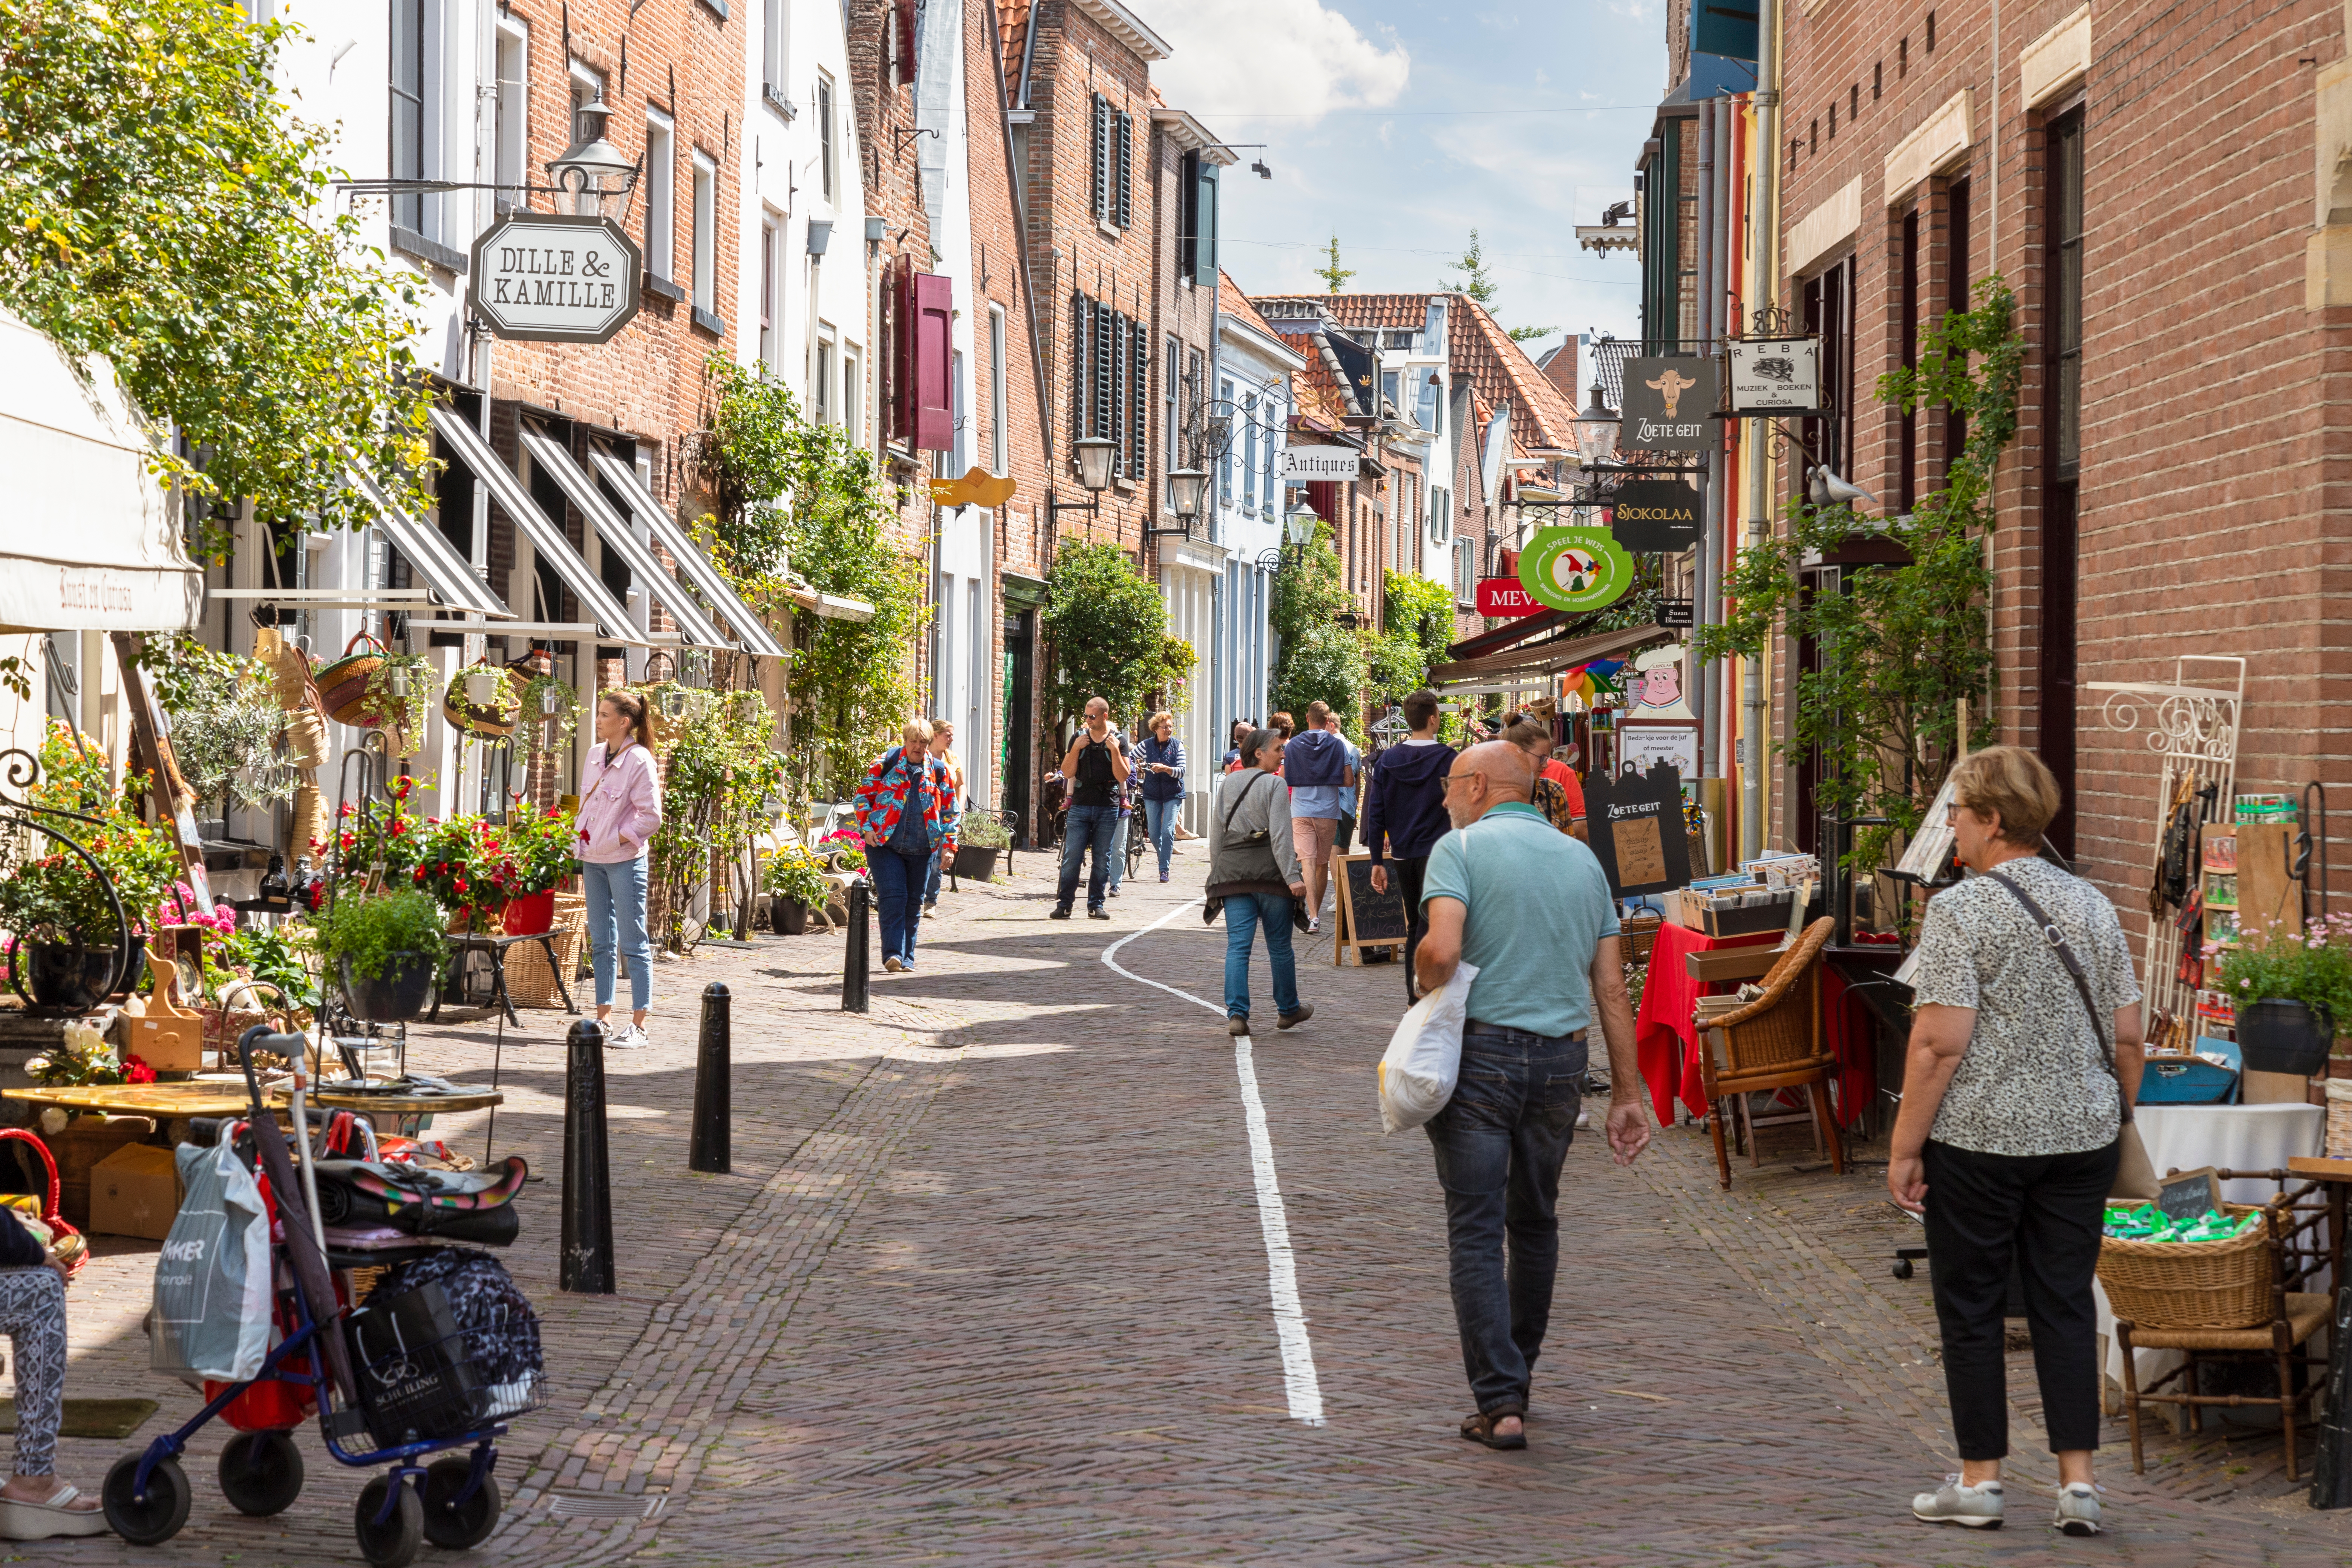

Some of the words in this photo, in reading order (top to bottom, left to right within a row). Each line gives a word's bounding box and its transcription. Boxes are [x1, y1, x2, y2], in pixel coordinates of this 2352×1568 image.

[500, 247, 574, 276] DILLE
[582, 251, 610, 277] &
[493, 278, 614, 309] KAMILLE
[1733, 344, 1814, 358] REBA
[1676, 424, 1702, 437] GEIT
[1286, 453, 1355, 476] Antiques
[1546, 536, 1572, 551] SPEEL
[1585, 537, 1605, 552] WIJS
[1490, 590, 1543, 606] MEV
[1539, 582, 1562, 600] SPEELGOED
[1572, 583, 1611, 603] HOBBYMATERIAAL
[1639, 802, 1661, 812] GEIT
